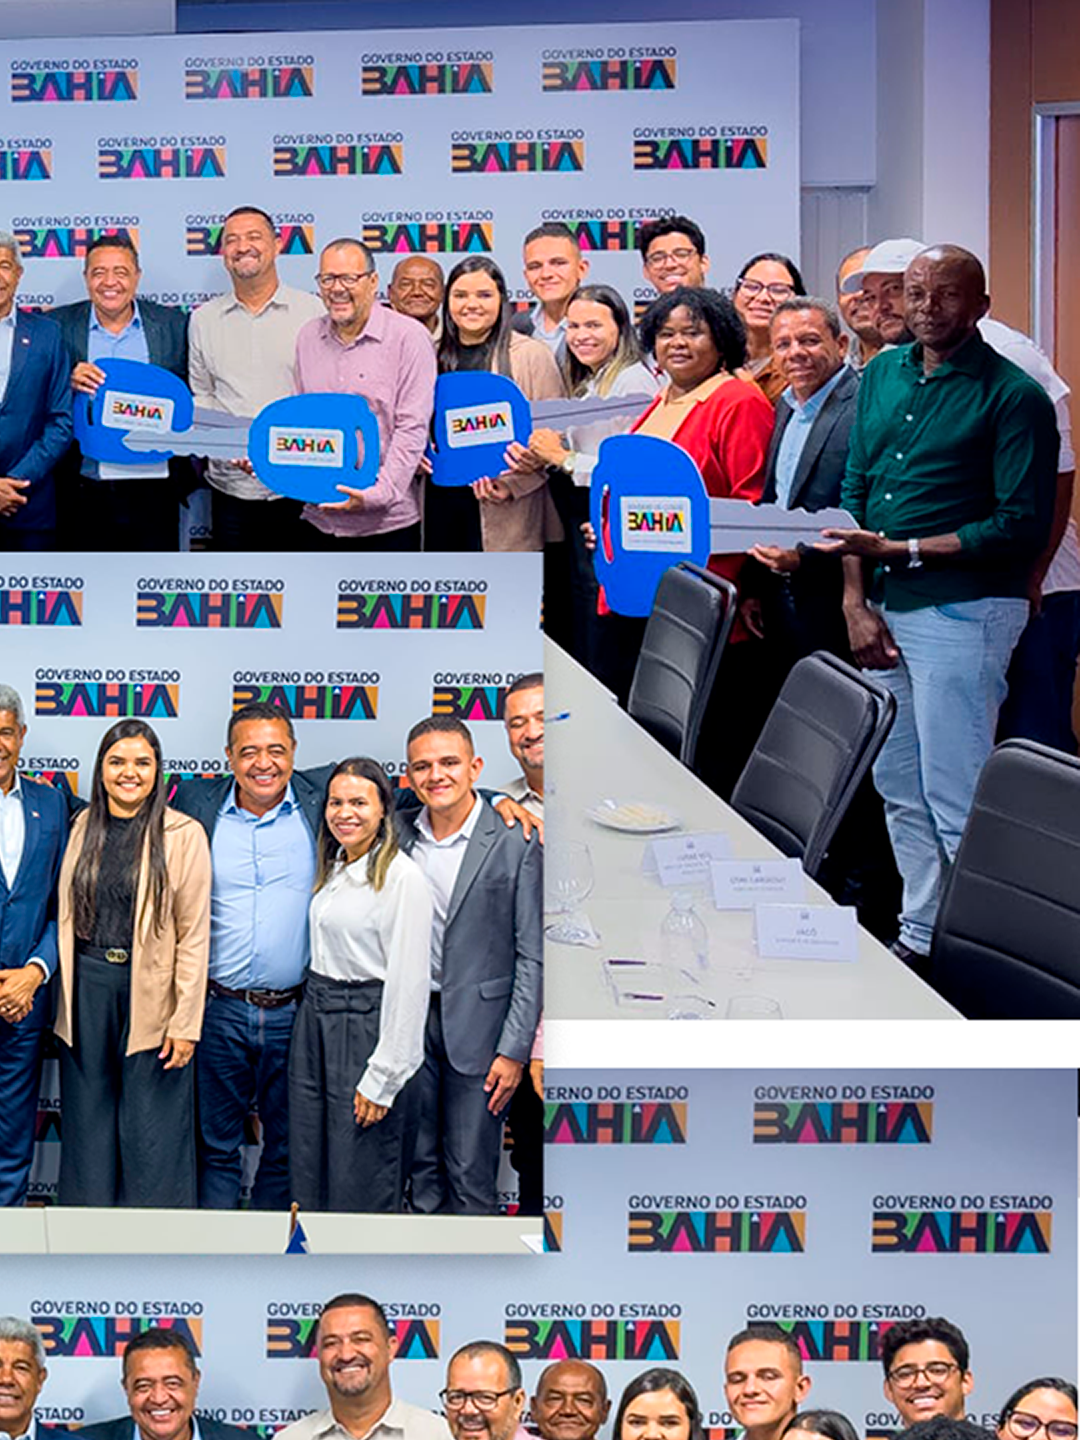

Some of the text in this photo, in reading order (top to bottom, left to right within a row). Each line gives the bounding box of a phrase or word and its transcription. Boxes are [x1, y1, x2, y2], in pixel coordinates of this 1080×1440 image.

[541, 45, 678, 61] GOVERNO DO ESTADO
[272, 131, 404, 147] GOVERNO DO ESTADO
[632, 125, 769, 139] GOVERNO DO ESTADO
[6, 137, 53, 150] ESTADO
[8, 575, 30, 589] DO
[31, 575, 85, 590] ESTADO
[136, 577, 285, 593] GOVERNO DO ESTADO
[337, 579, 489, 594] GOVERNO DO ESTADO
[34, 667, 181, 683] GOVERNO DO ESTADO
[753, 1084, 936, 1101] GOVERNO DO ESTADO
[628, 1194, 808, 1210] GOVERNO DO ESTADO
[872, 1194, 1054, 1211] GOVERNO DO ESTADO
